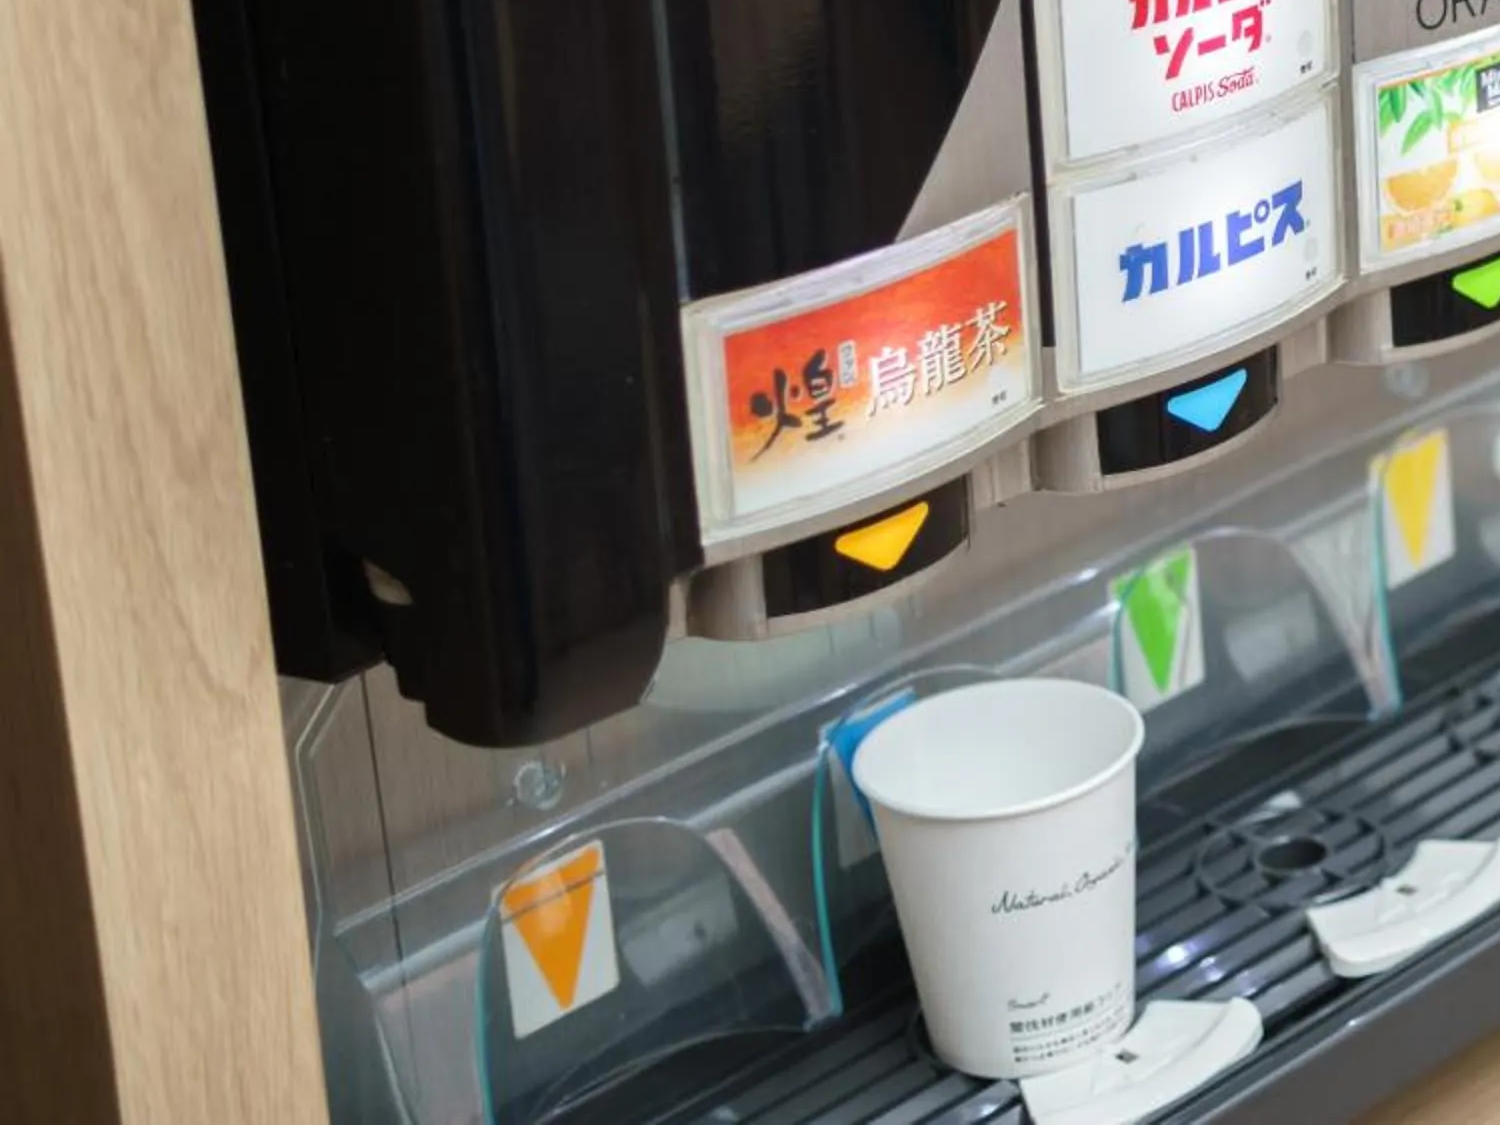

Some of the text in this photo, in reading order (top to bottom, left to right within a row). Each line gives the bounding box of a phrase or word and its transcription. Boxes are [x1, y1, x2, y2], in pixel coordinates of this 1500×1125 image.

[1171, 67, 1255, 112] CALPIS Soda
[1119, 179, 1305, 303] カルピス
[865, 302, 1012, 419] 烏龍茶
